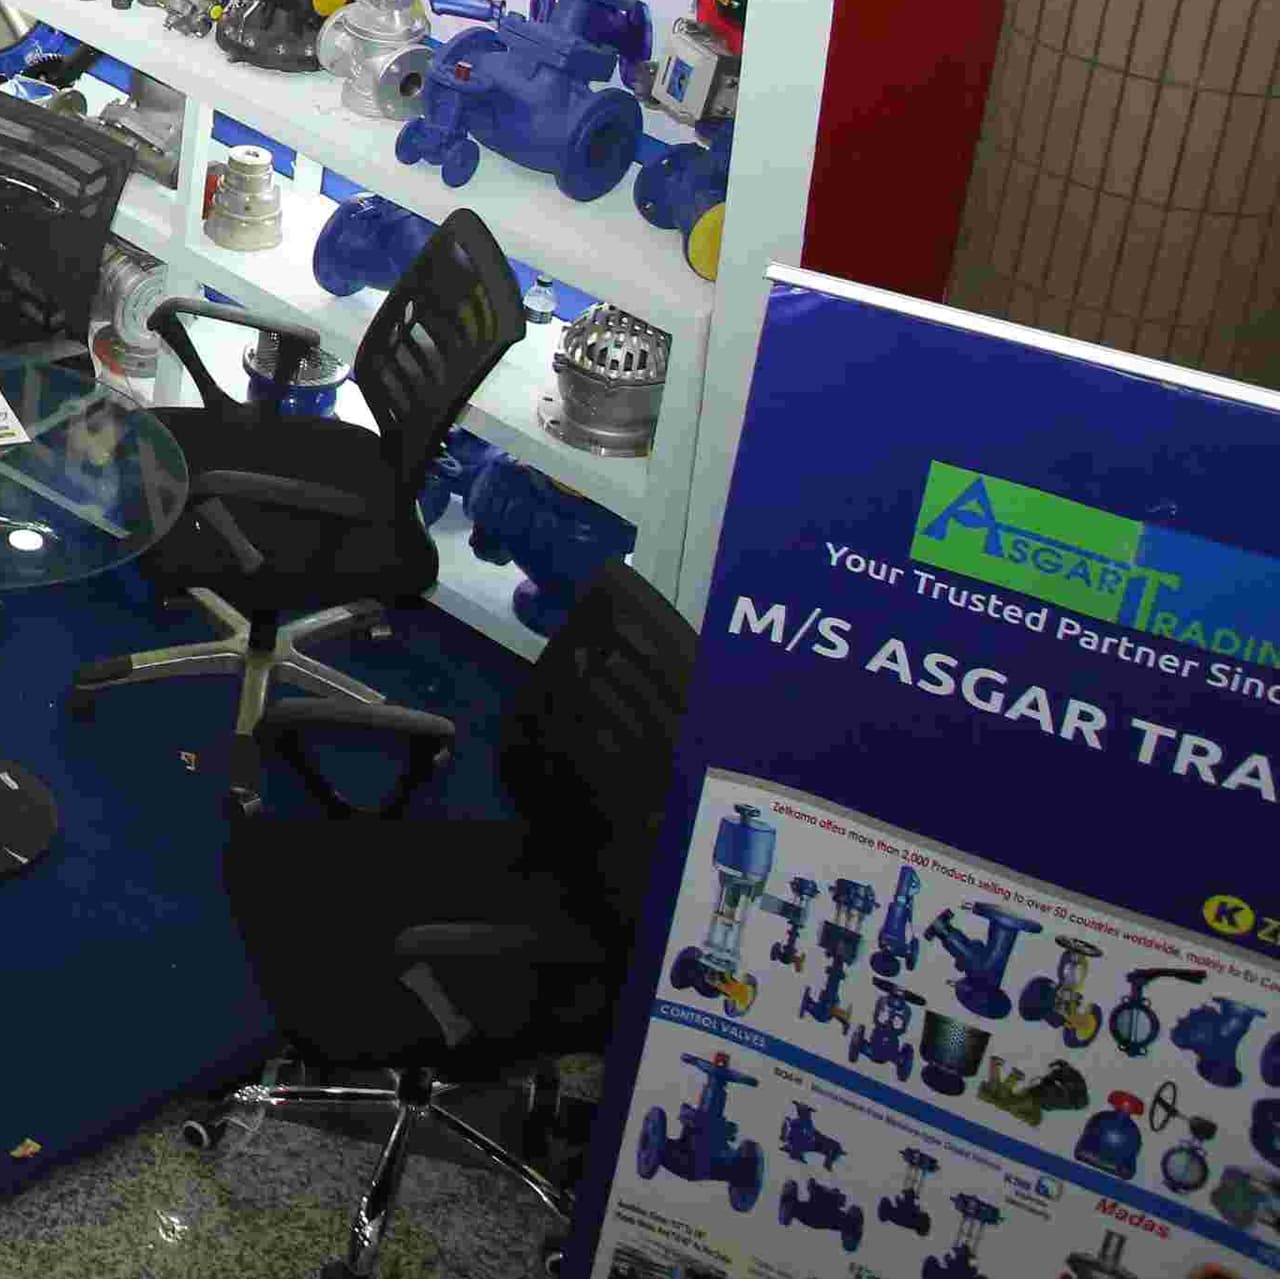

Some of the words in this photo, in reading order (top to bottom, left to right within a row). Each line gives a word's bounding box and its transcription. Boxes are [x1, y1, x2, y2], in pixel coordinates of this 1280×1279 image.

[922, 476, 1123, 595] ASGAR
[825, 541, 904, 585] Your
[912, 568, 1045, 633] Trusted
[1056, 618, 1199, 679] Partner
[727, 596, 852, 659] M/S
[866, 639, 1107, 750] ASGAR
[1131, 718, 1279, 802] TRA
[773, 802, 817, 826] Zetkama
[848, 830, 876, 848] more
[876, 839, 900, 858] than
[660, 1004, 721, 1030] CONTROL
[720, 1023, 768, 1049] VALVES
[1095, 1197, 1171, 1240] Madas
